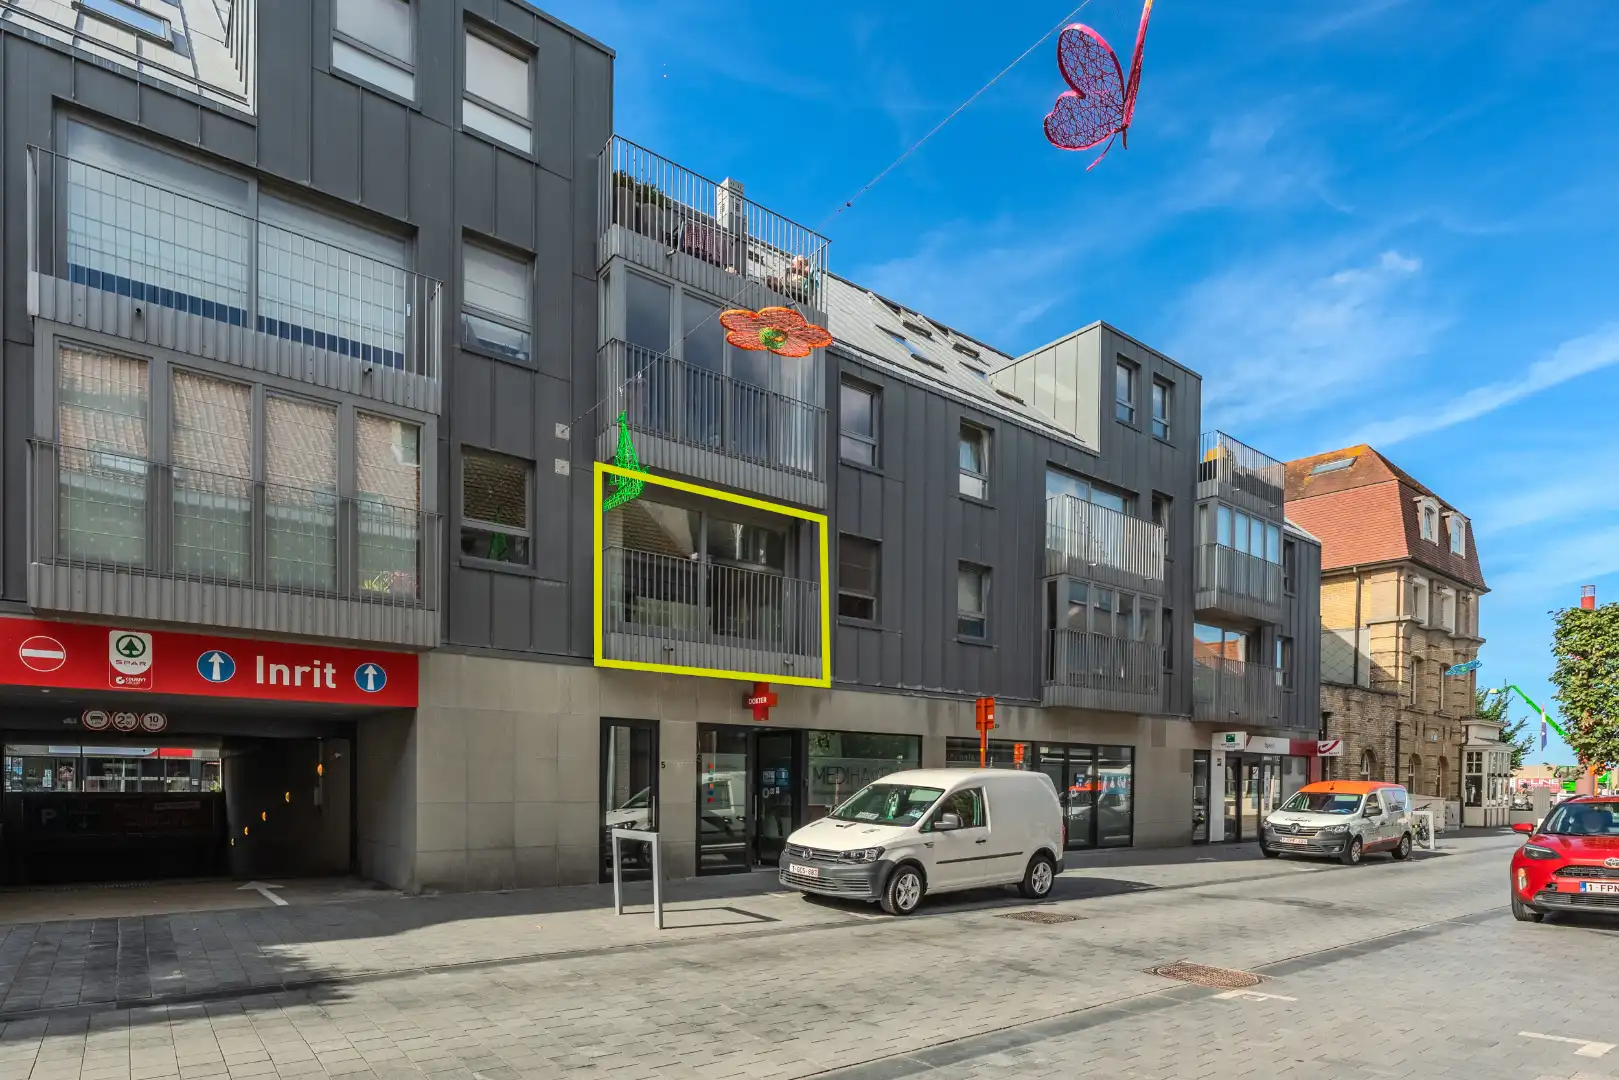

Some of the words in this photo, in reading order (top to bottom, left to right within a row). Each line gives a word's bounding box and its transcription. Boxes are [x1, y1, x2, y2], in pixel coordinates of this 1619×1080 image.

[115, 659, 147, 667] SPAR
[256, 655, 337, 689] Inrit
[148, 715, 159, 723] 10
[661, 761, 666, 769] 5
